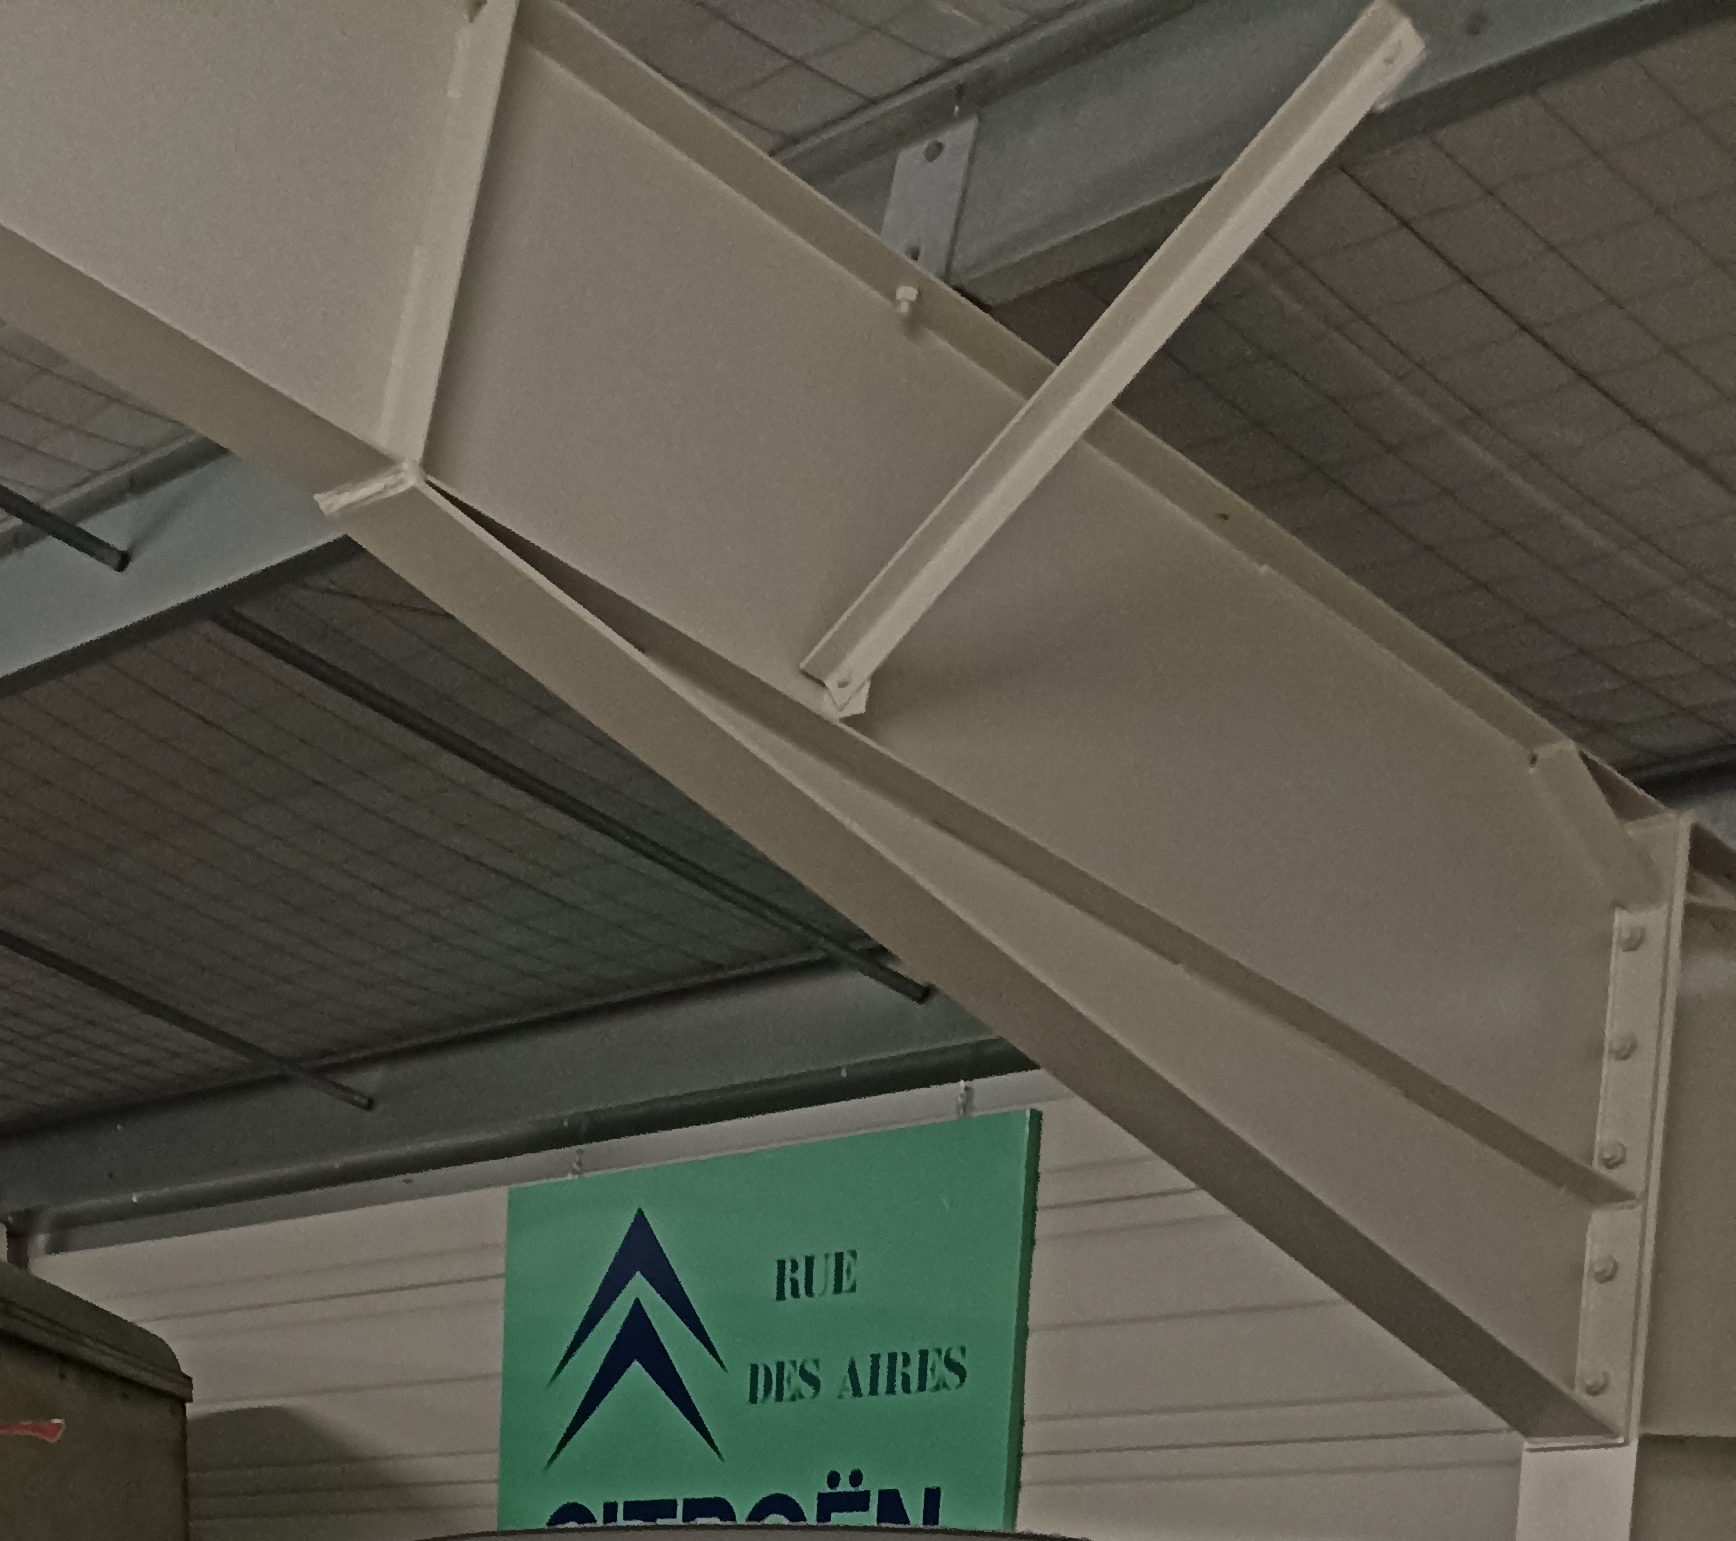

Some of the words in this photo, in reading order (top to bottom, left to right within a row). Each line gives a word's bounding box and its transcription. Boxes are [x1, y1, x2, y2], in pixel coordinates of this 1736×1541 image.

[775, 1250, 857, 1301] RUE
[747, 1357, 822, 1405] DES
[838, 1345, 968, 1400] AIRES
